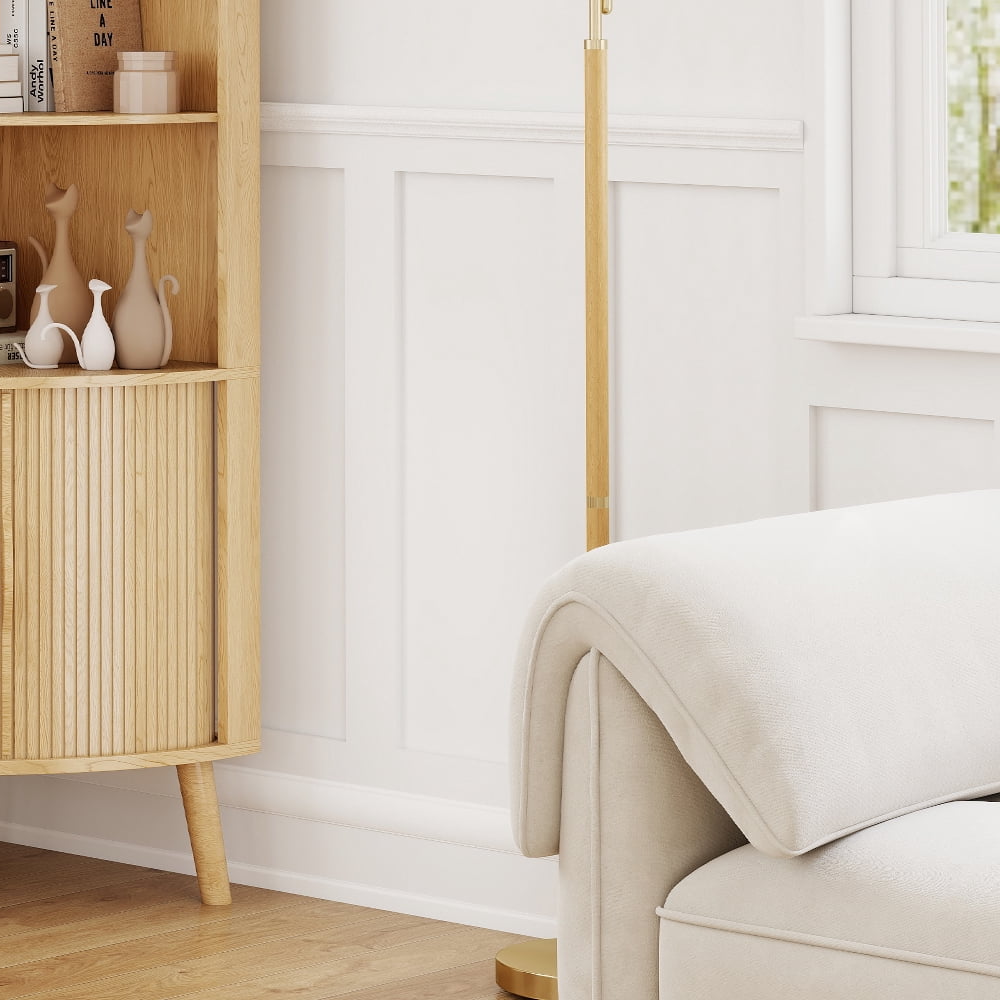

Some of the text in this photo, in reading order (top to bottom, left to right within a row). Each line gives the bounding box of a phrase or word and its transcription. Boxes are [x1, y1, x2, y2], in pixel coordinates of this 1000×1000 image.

[99, 13, 106, 28] A
[94, 32, 113, 47] DAY
[30, 64, 39, 98] Andy
